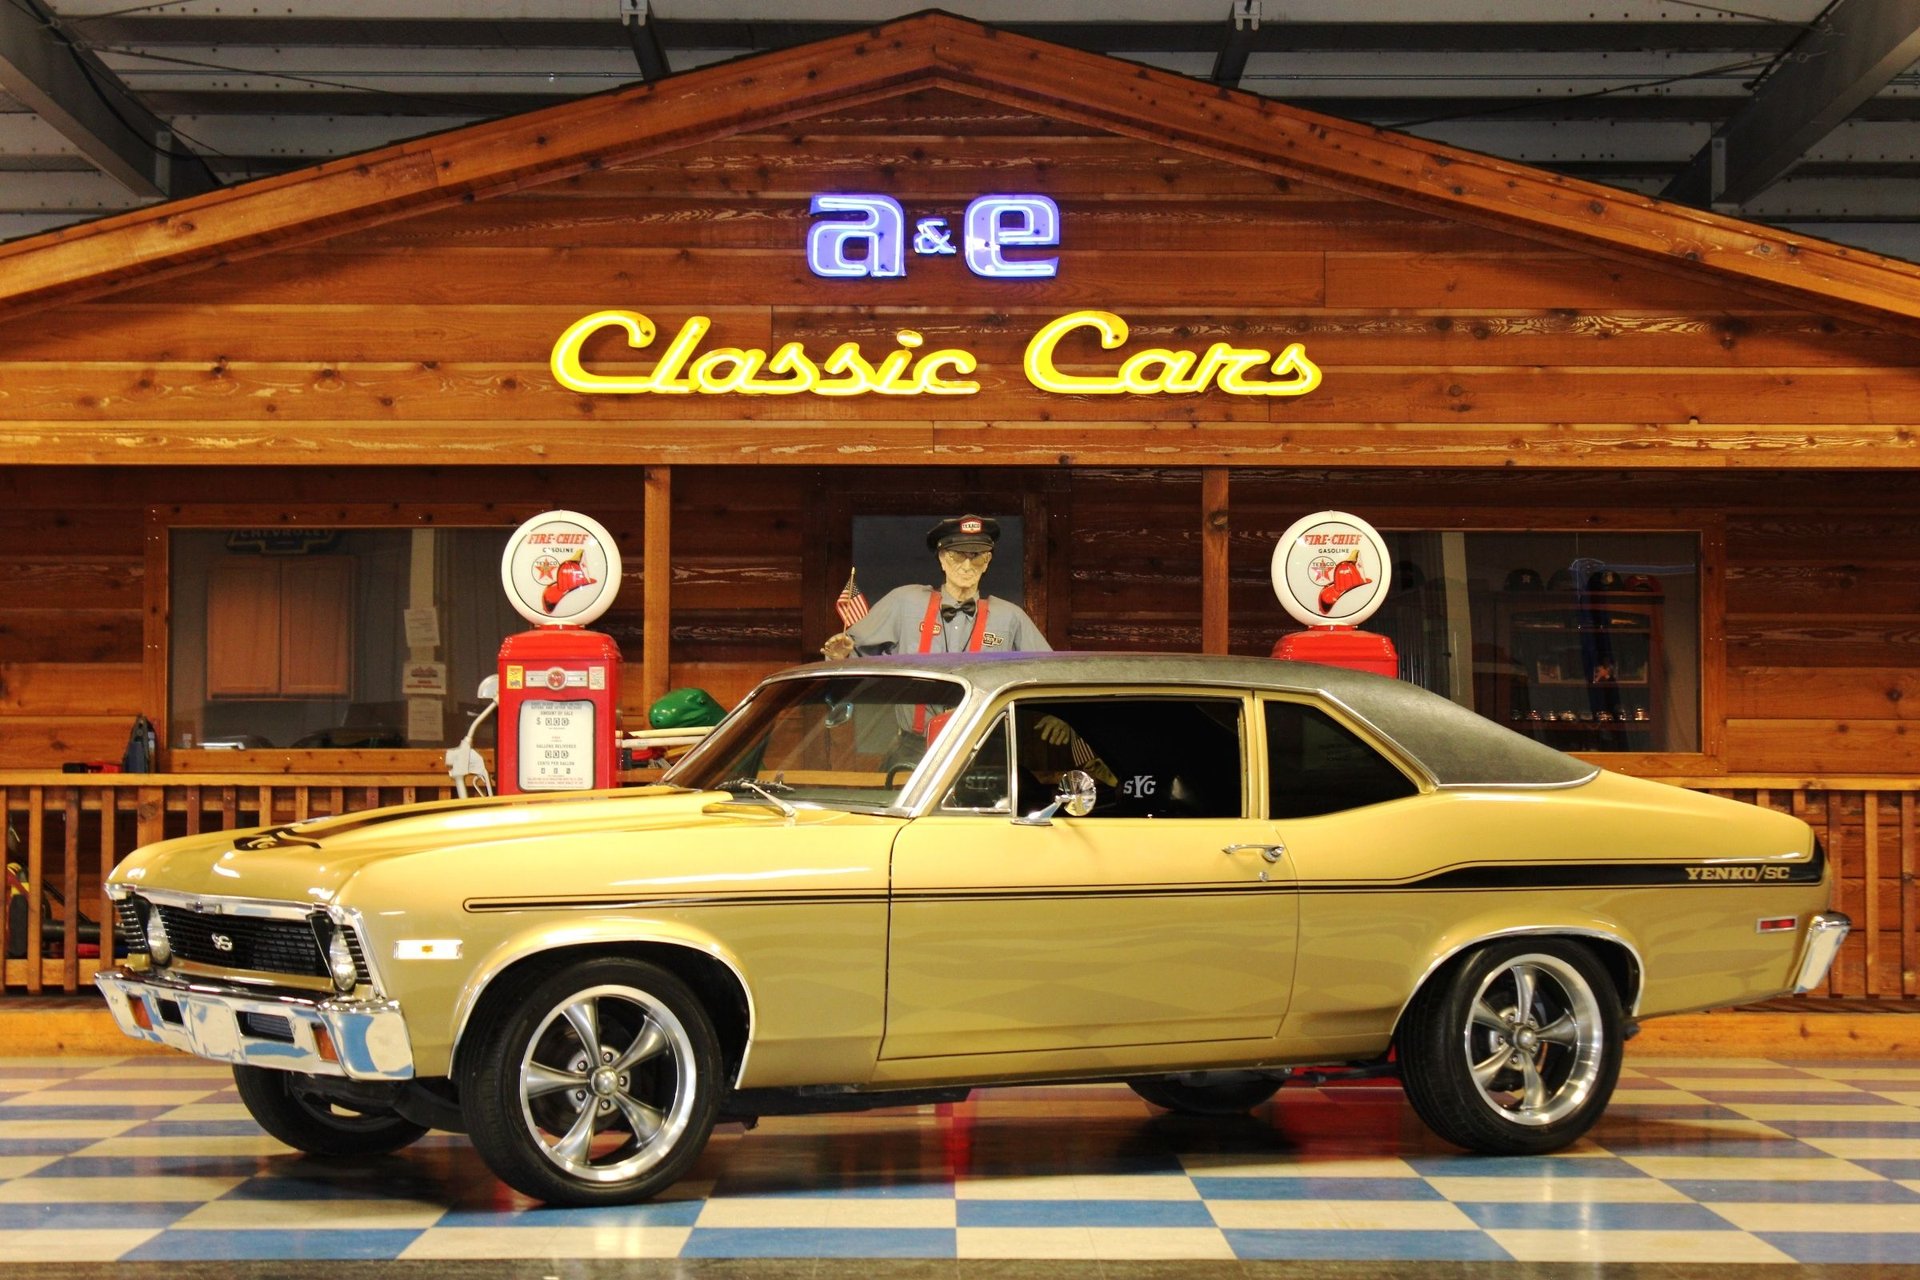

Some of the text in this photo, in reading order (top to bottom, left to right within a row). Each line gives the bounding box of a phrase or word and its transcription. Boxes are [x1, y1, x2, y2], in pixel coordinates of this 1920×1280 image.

[807, 194, 1060, 278] a & e
[550, 310, 1322, 395] Classic Cars
[528, 534, 588, 544] FIRE-CHIEF
[1304, 535, 1361, 545] FIRE-CHIEF
[1685, 866, 1790, 881] YENKO/SC
